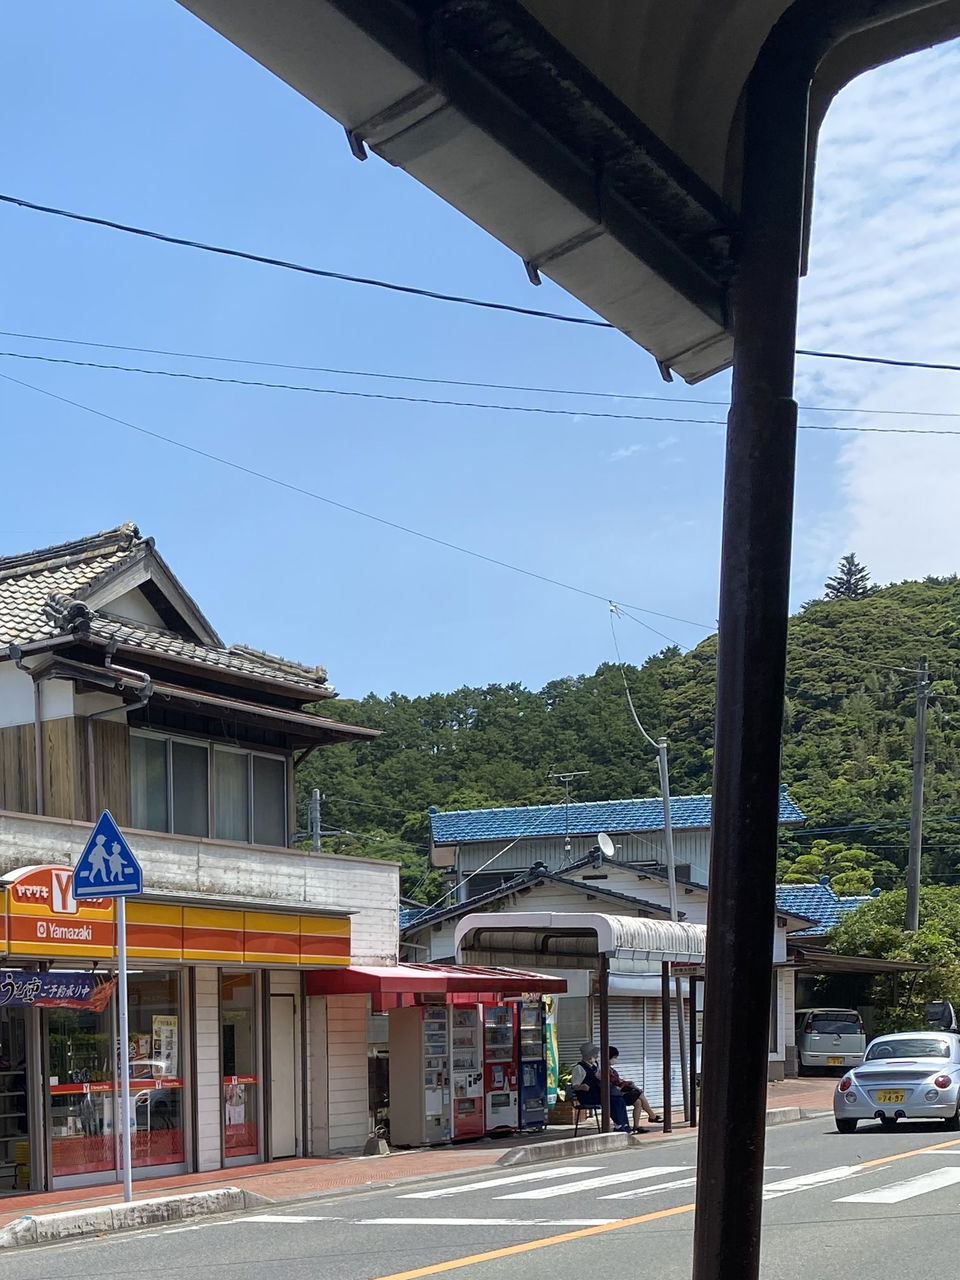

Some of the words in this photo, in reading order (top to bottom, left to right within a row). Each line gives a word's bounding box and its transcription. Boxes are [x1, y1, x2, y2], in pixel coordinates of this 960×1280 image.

[16, 884, 49, 899] ヤマザキ
[49, 923, 92, 941] Yamazaki
